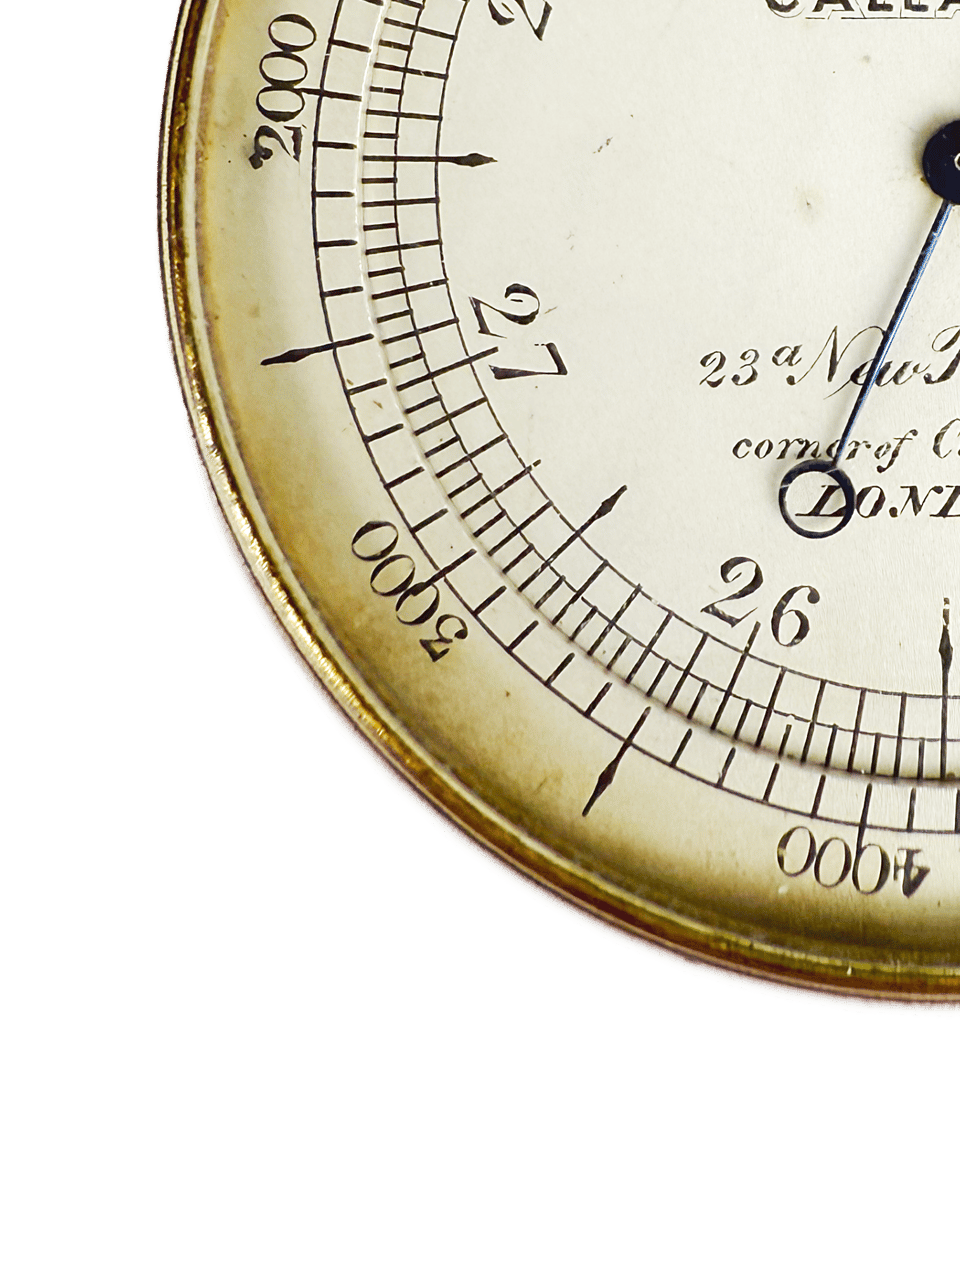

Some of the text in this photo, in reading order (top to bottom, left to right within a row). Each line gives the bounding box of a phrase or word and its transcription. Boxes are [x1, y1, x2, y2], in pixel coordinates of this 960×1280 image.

[249, 13, 317, 170] 2000
[470, 283, 569, 381] 27
[871, 428, 918, 473] of
[350, 520, 469, 663] 3000
[700, 555, 821, 648] 26
[776, 825, 931, 898] 4000
